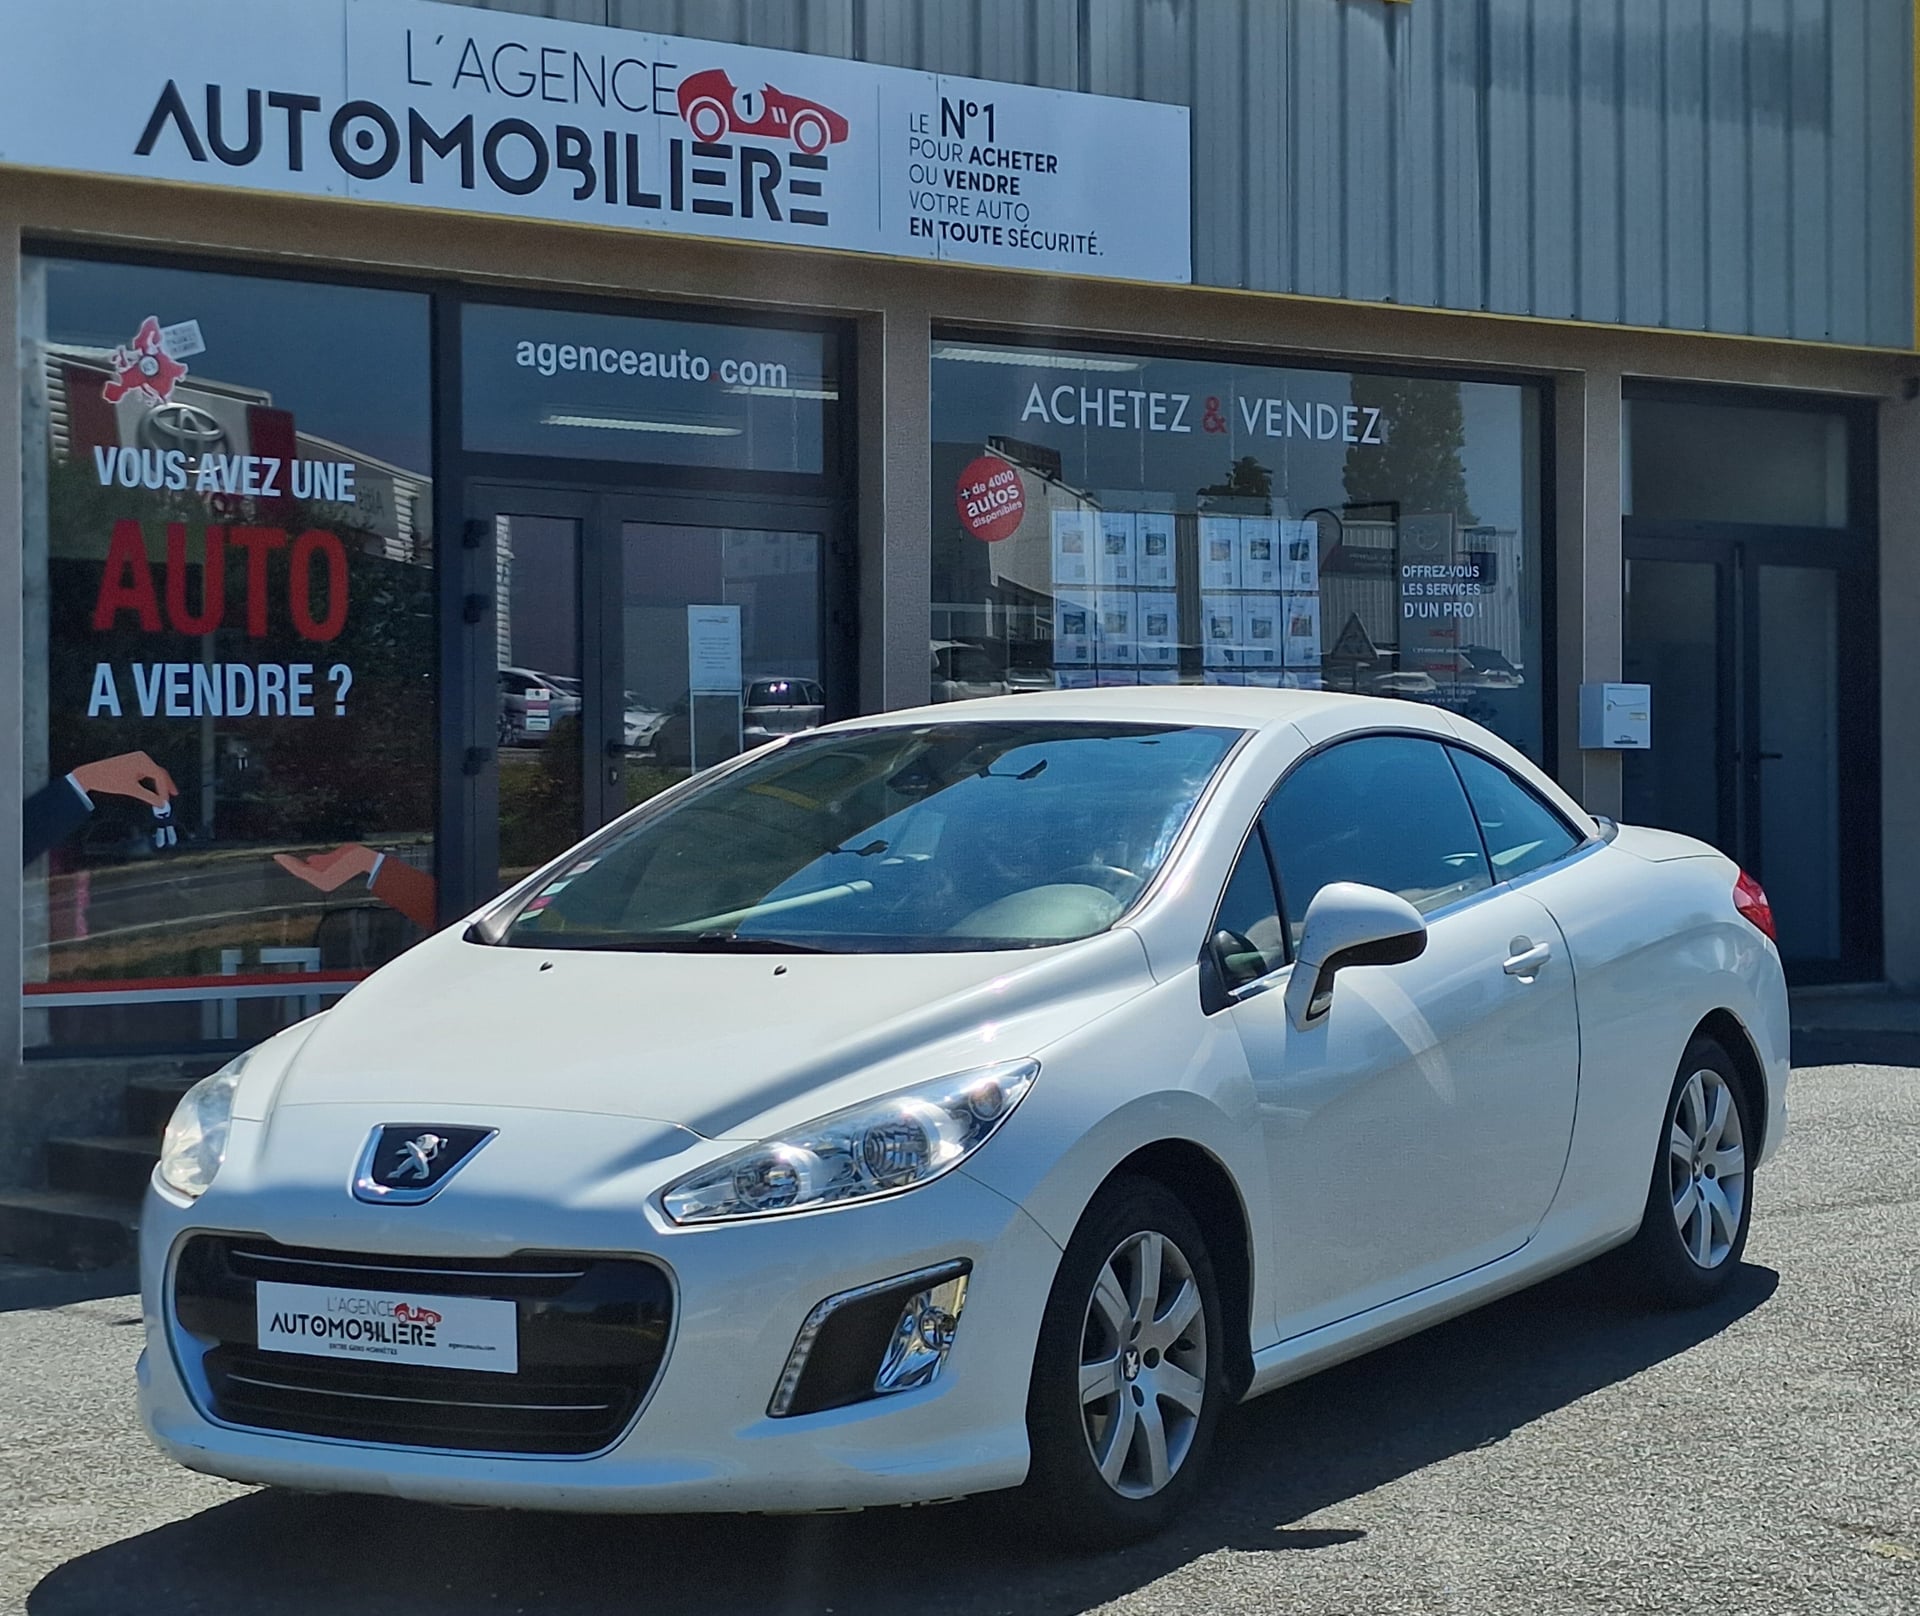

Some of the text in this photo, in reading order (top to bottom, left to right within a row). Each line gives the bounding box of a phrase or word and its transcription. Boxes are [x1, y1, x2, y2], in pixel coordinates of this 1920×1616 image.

[406, 30, 679, 117] L'AGENCE
[741, 92, 754, 115] 1
[909, 112, 929, 134] LE
[909, 138, 1058, 174] POUR ACHETER
[909, 164, 1021, 196] OU VENDRE
[909, 190, 1031, 223] VOTRE AUTO
[909, 217, 1104, 257] EN TOUTE SÉCURITÉ.
[516, 340, 788, 387] agenceauto.com
[1021, 382, 1382, 445] ACHETEZ & VENDEZ
[94, 446, 187, 490] VOUS
[195, 453, 281, 497] AVEZ
[290, 459, 356, 502] UNE
[960, 470, 1014, 500] + de 4000
[967, 485, 1019, 517] autos
[972, 501, 1022, 528] disponibles
[92, 519, 350, 642] AUTO
[1402, 565, 1480, 578] OFFREZ-VOUS
[1402, 583, 1480, 596] LES SERVICES
[1404, 602, 1483, 619] D'UN PRO !
[88, 663, 354, 718] A VENDRE ?
[327, 1296, 394, 1317] L'AGENCE
